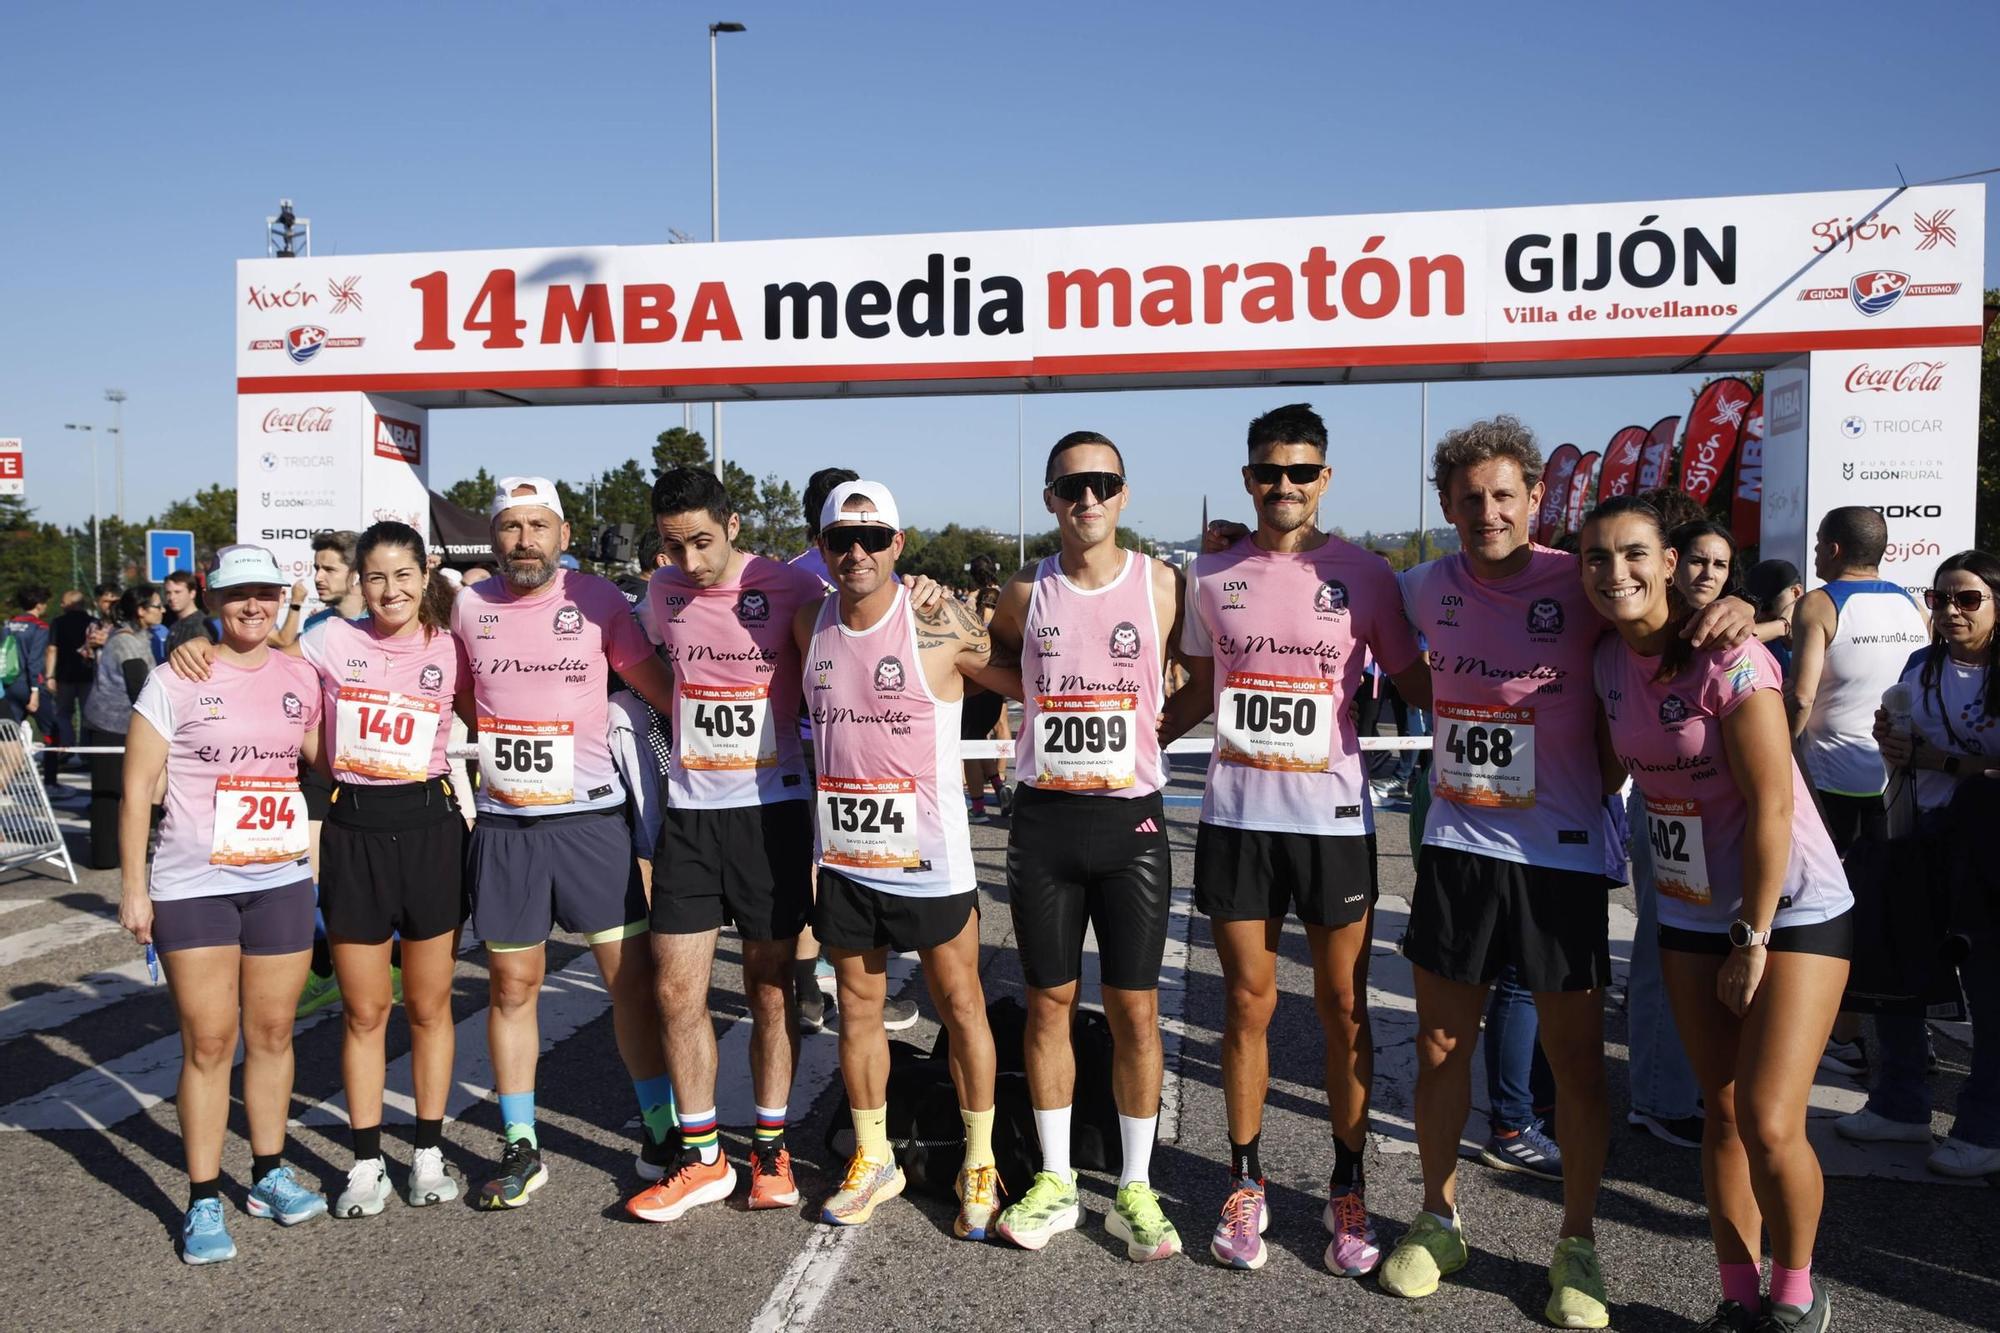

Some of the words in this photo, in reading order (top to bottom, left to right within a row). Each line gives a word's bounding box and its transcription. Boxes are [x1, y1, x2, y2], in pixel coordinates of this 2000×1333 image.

[1504, 214, 1738, 294] GIJÓN
[410, 268, 528, 350] 14
[539, 280, 743, 344] MBA
[765, 253, 1024, 340] media
[1047, 235, 1465, 330] maratón
[1809, 288, 1844, 300] GIJÓN
[1908, 285, 1952, 295] ATLETISMO
[1503, 306, 1558, 325] Villa
[1567, 304, 1598, 322] de
[1606, 300, 1739, 320] Jovellanos
[377, 420, 417, 451] MBA
[1873, 419, 1943, 433] TRIOCAR
[284, 456, 334, 468] TRIOCAR
[1860, 469, 1943, 481] GIJÓNRURAL
[262, 528, 335, 540] SIROK
[1884, 538, 1940, 562] gijón
[1244, 635, 1341, 660] Monolito
[1852, 632, 1926, 645] www.run04.com
[491, 657, 590, 675] Monolito
[688, 645, 778, 662] Monolito
[1454, 655, 1569, 680] Monolito
[1058, 674, 1141, 693] Monolito
[358, 707, 416, 745] 140
[694, 704, 756, 738] 403
[832, 707, 912, 725] Monolito
[1233, 693, 1317, 736] 1050
[1044, 715, 1127, 753] 2099
[1446, 724, 1513, 768] 468
[494, 738, 554, 773] 565
[237, 795, 295, 831] 294
[827, 796, 905, 833] 1324
[1648, 815, 1690, 863] 402
